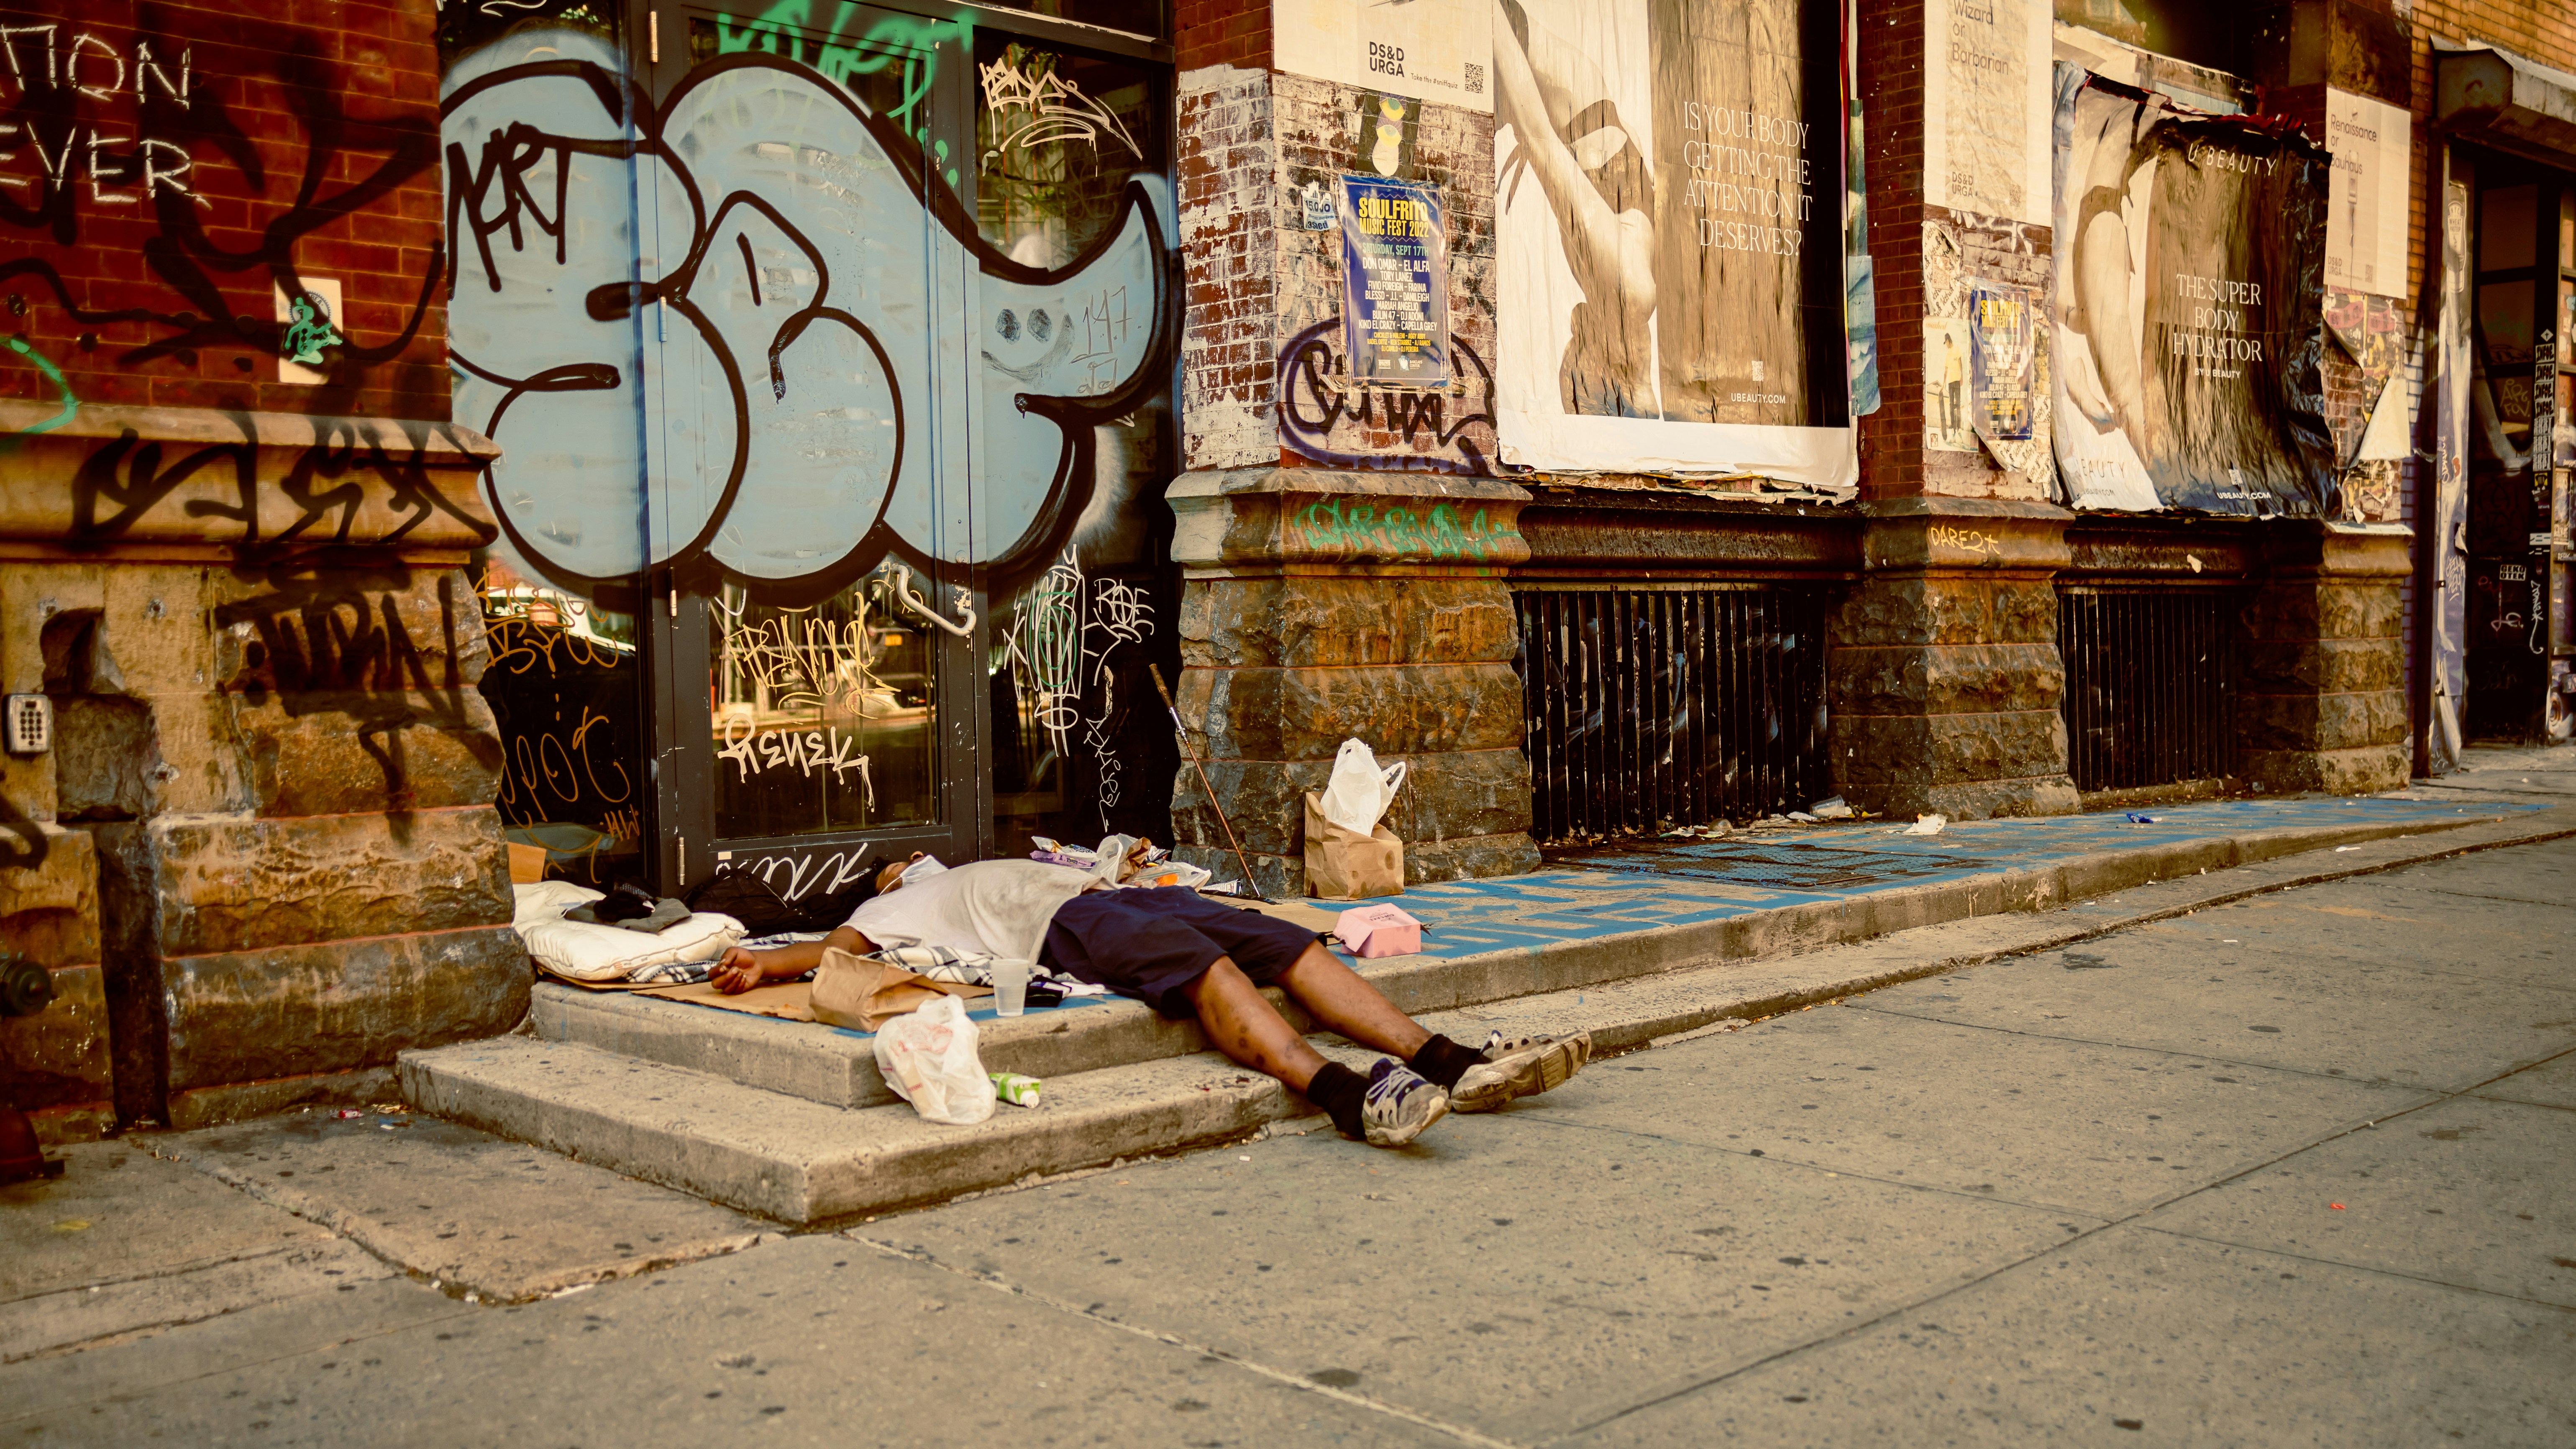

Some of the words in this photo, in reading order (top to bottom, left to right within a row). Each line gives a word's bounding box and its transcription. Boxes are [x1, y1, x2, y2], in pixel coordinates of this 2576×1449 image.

[1953, 0, 1993, 26] Wizard
[1952, 20, 1965, 38] or
[1369, 41, 1404, 61] DS&D
[1952, 42, 2009, 76] Barbarian
[1370, 57, 1405, 78] URGA
[1411, 73, 1422, 82] Take
[1433, 78, 1458, 89] #sniffquiz
[1684, 102, 1700, 130] IS
[1704, 105, 1755, 140] YOUR
[1759, 115, 1809, 149] BODY
[2331, 114, 2377, 142] Renaissance
[2330, 135, 2339, 147] or
[1684, 141, 1771, 179] GETTING
[1774, 155, 1811, 185] THE
[2188, 143, 2199, 162] U
[2207, 146, 2276, 176] BEAUTY
[1952, 172, 1973, 185] DS&D
[1684, 179, 1793, 219] ATTENTION
[1798, 194, 1813, 221] IT
[1952, 184, 1973, 198] URGA
[1359, 197, 1429, 221] SOULFRITO
[1359, 218, 1385, 235] MUSIC
[1387, 220, 1407, 236] FEST
[1409, 221, 1429, 238] 2022
[1700, 218, 1802, 256] DESERVES?
[1362, 243, 1394, 256] SATURDAY,
[1396, 245, 1411, 256] SEPT
[1413, 246, 1429, 256] 17TH
[1362, 257, 1377, 270] DON
[1378, 258, 1397, 271] OMAR
[1404, 260, 1412, 272] EL
[1413, 261, 1430, 272] ALFA
[2328, 266, 2342, 276] URGA
[1380, 271, 1394, 282] TORY
[1396, 271, 1413, 282] LANEZ
[1365, 290, 1385, 300] BLESSD
[1403, 292, 1429, 302] DANILEIGH
[1368, 281, 1381, 290] FIVIO
[1382, 282, 1403, 292] FOREIGN
[1408, 282, 1426, 293] FARINA
[2177, 274, 2206, 300] THE
[2209, 278, 2261, 305] SUPER
[1373, 310, 1388, 320] BULIN
[1388, 311, 1396, 320] 47
[1401, 312, 1408, 320] DJ
[1408, 312, 1424, 321] ADONI
[1377, 301, 1397, 310] MARIAH
[1398, 302, 1419, 312] ANGELIQ
[1359, 320, 1371, 329] KIKO
[1372, 320, 1379, 329] EL
[1380, 320, 1396, 330] CRAZY
[1401, 321, 1423, 330] CAPELLA
[1424, 322, 1437, 331] GREY
[2195, 306, 2239, 332] BODY
[2174, 333, 2263, 361] HYDRATOR
[2212, 369, 2241, 378] BEAUTY
[1731, 393, 1786, 404] UBEAUTY.COM
[2076, 458, 2125, 479] EAUTY
